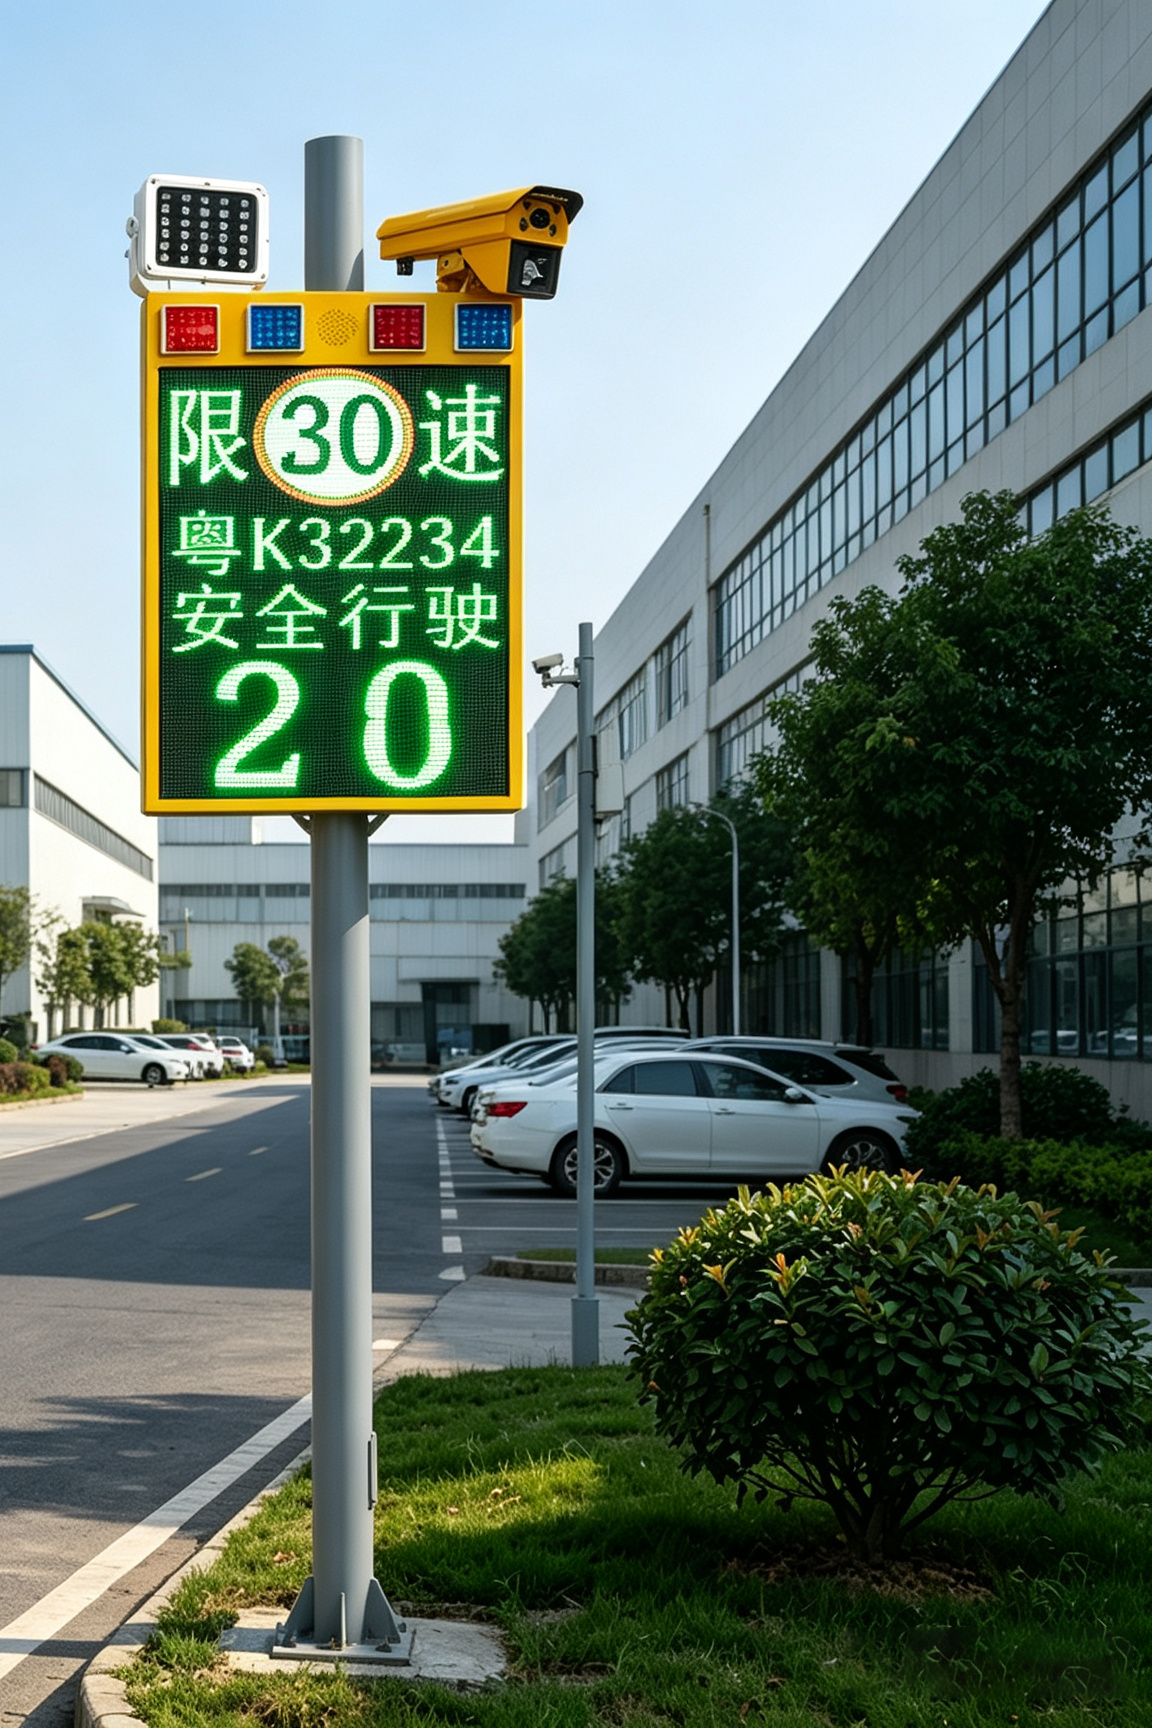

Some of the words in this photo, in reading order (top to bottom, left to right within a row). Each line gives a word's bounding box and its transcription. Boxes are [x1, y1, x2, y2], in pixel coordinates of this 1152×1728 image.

[169, 389, 250, 486] 限
[280, 394, 394, 475] 30
[418, 384, 505, 481] 速
[171, 509, 500, 576] 粤K32234
[171, 583, 500, 652] 安全行驶
[214, 660, 452, 789] 20
